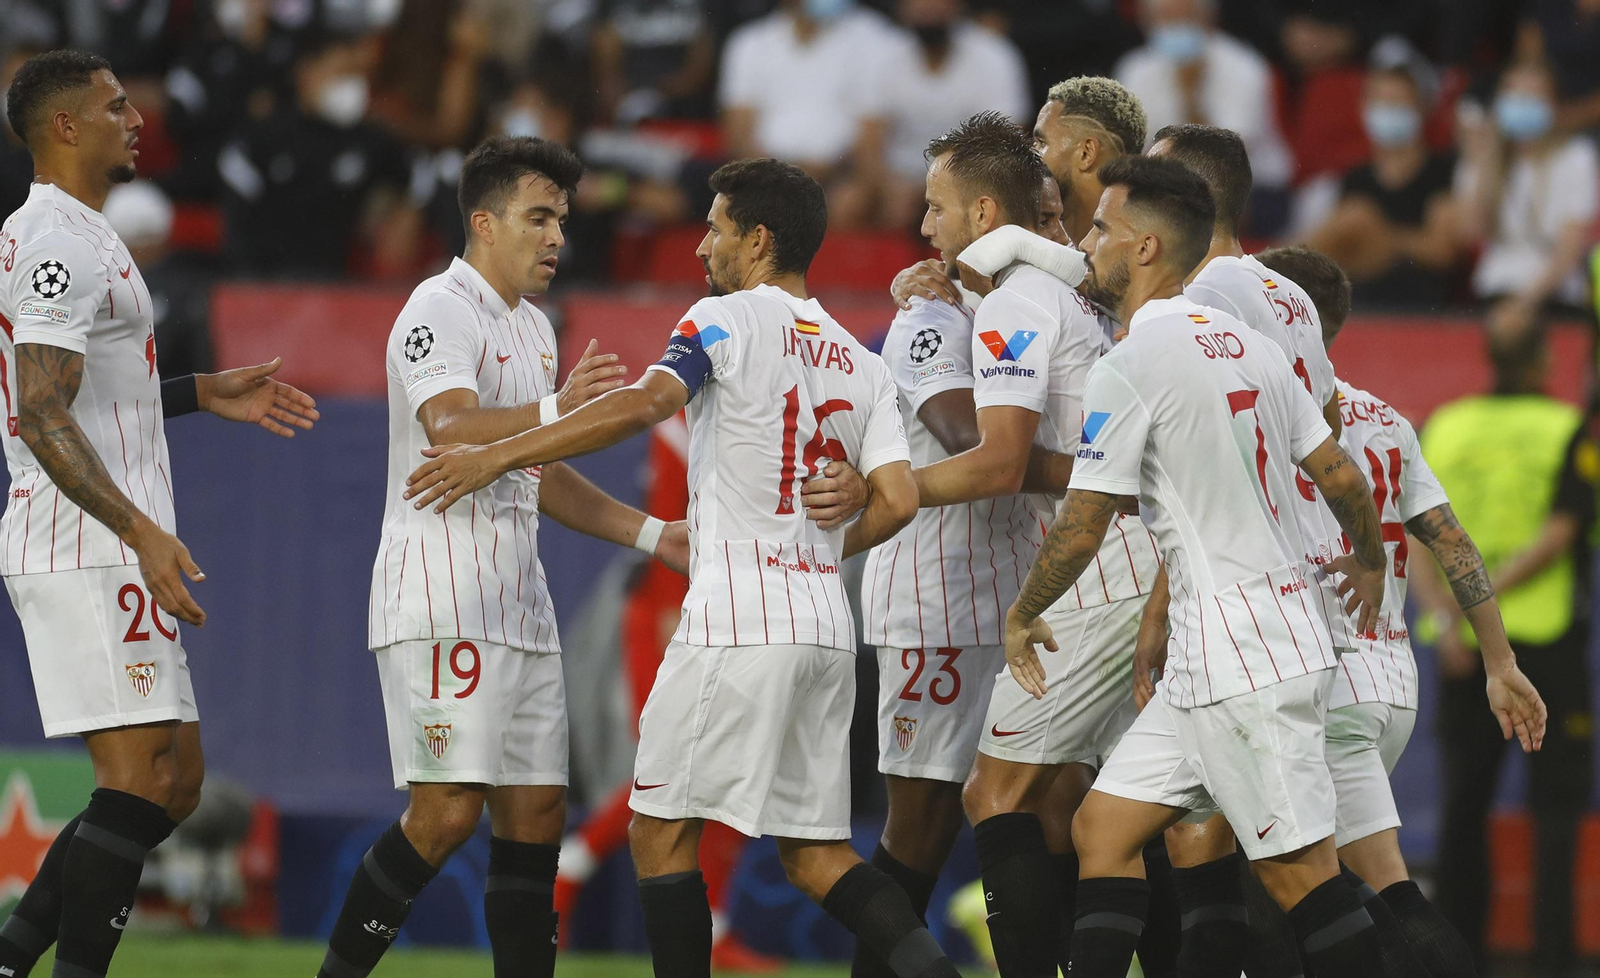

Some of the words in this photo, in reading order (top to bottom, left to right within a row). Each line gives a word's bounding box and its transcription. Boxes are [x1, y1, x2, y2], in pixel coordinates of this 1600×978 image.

[20, 306, 69, 319] FOUNDATION
[1195, 331, 1245, 360] SUSO
[980, 365, 1035, 379] Valvoline
[1226, 389, 1281, 528] 7
[430, 641, 481, 699] 19
[898, 647, 963, 705] 23
